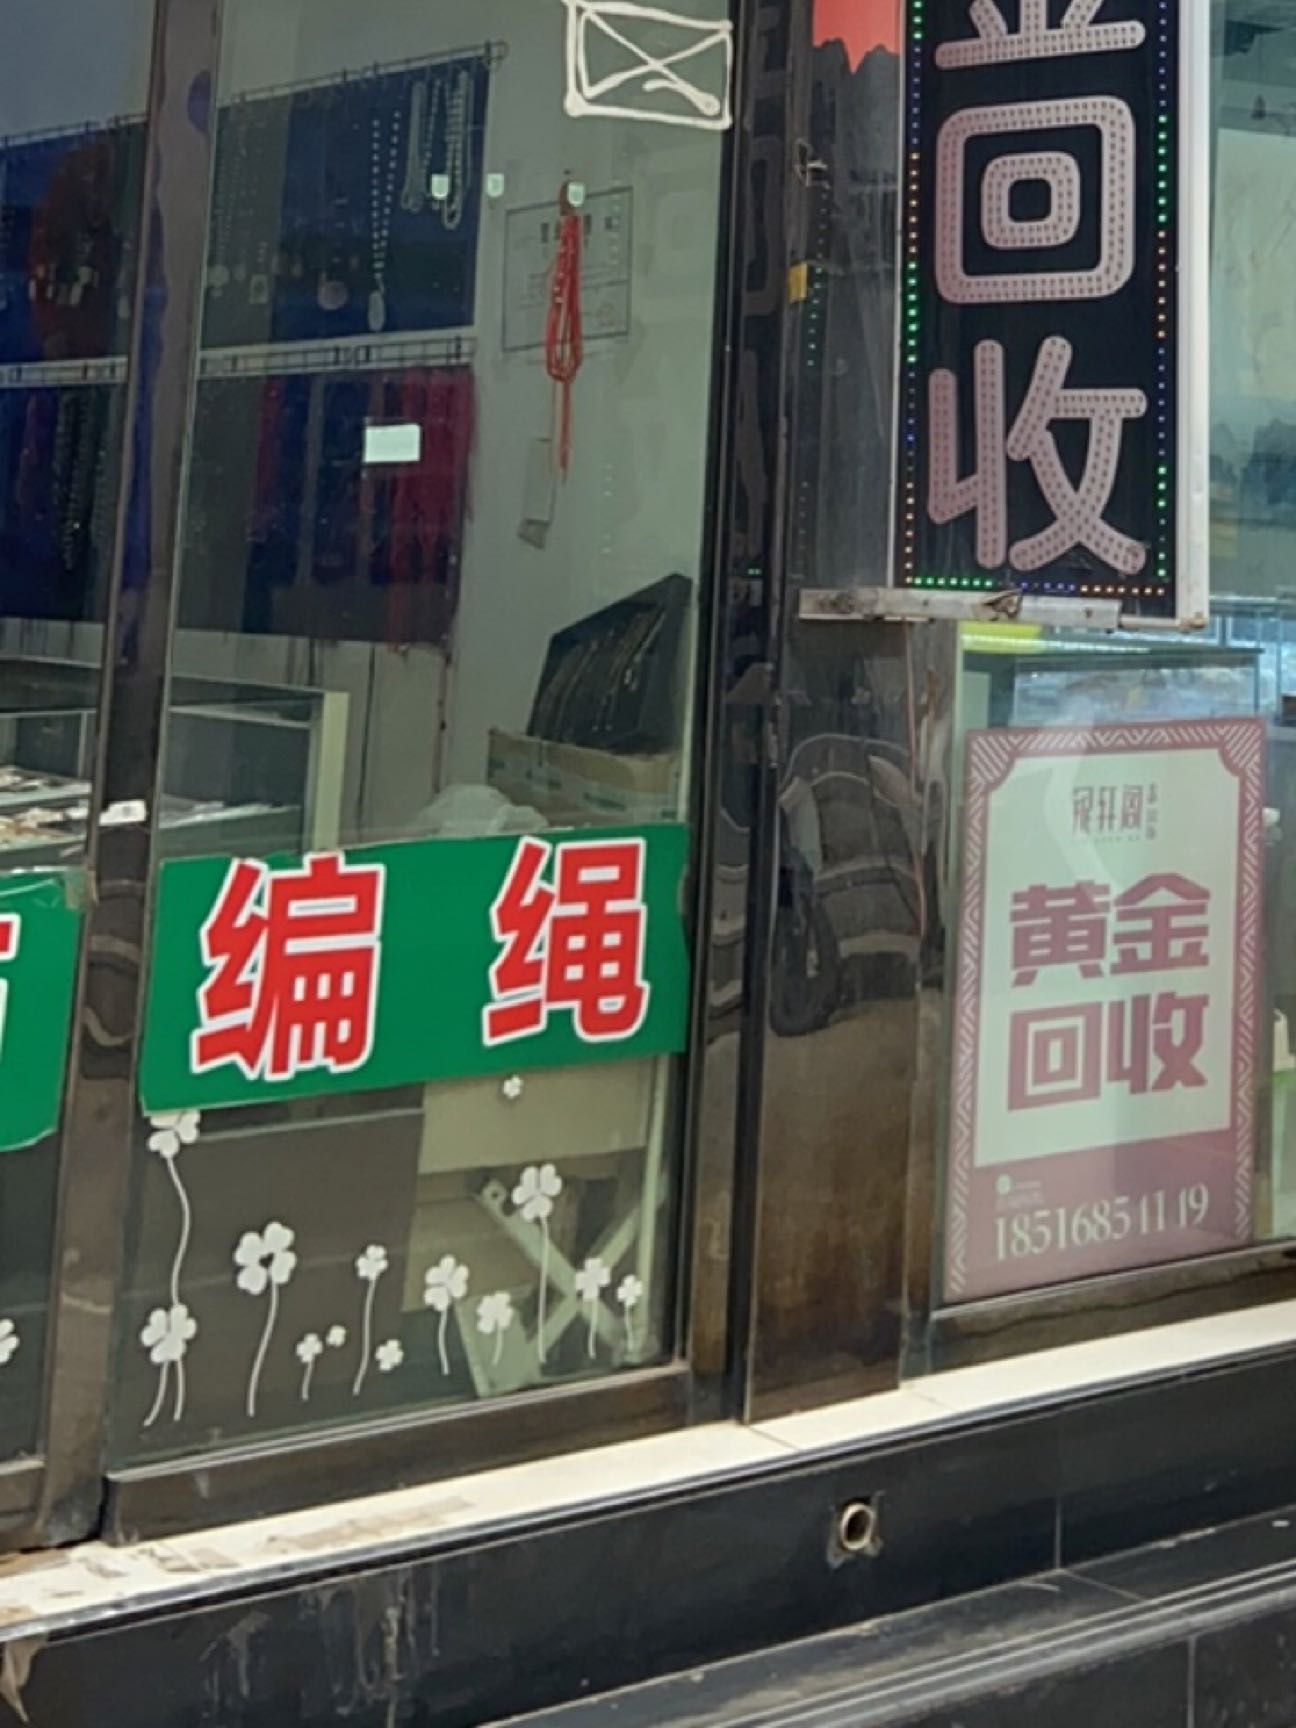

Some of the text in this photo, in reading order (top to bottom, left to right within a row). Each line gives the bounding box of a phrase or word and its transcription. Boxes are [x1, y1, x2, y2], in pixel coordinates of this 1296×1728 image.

[189, 837, 651, 1081] 编绳
[1009, 872, 1212, 988] 黄金
[1007, 991, 1210, 1113] 回收
